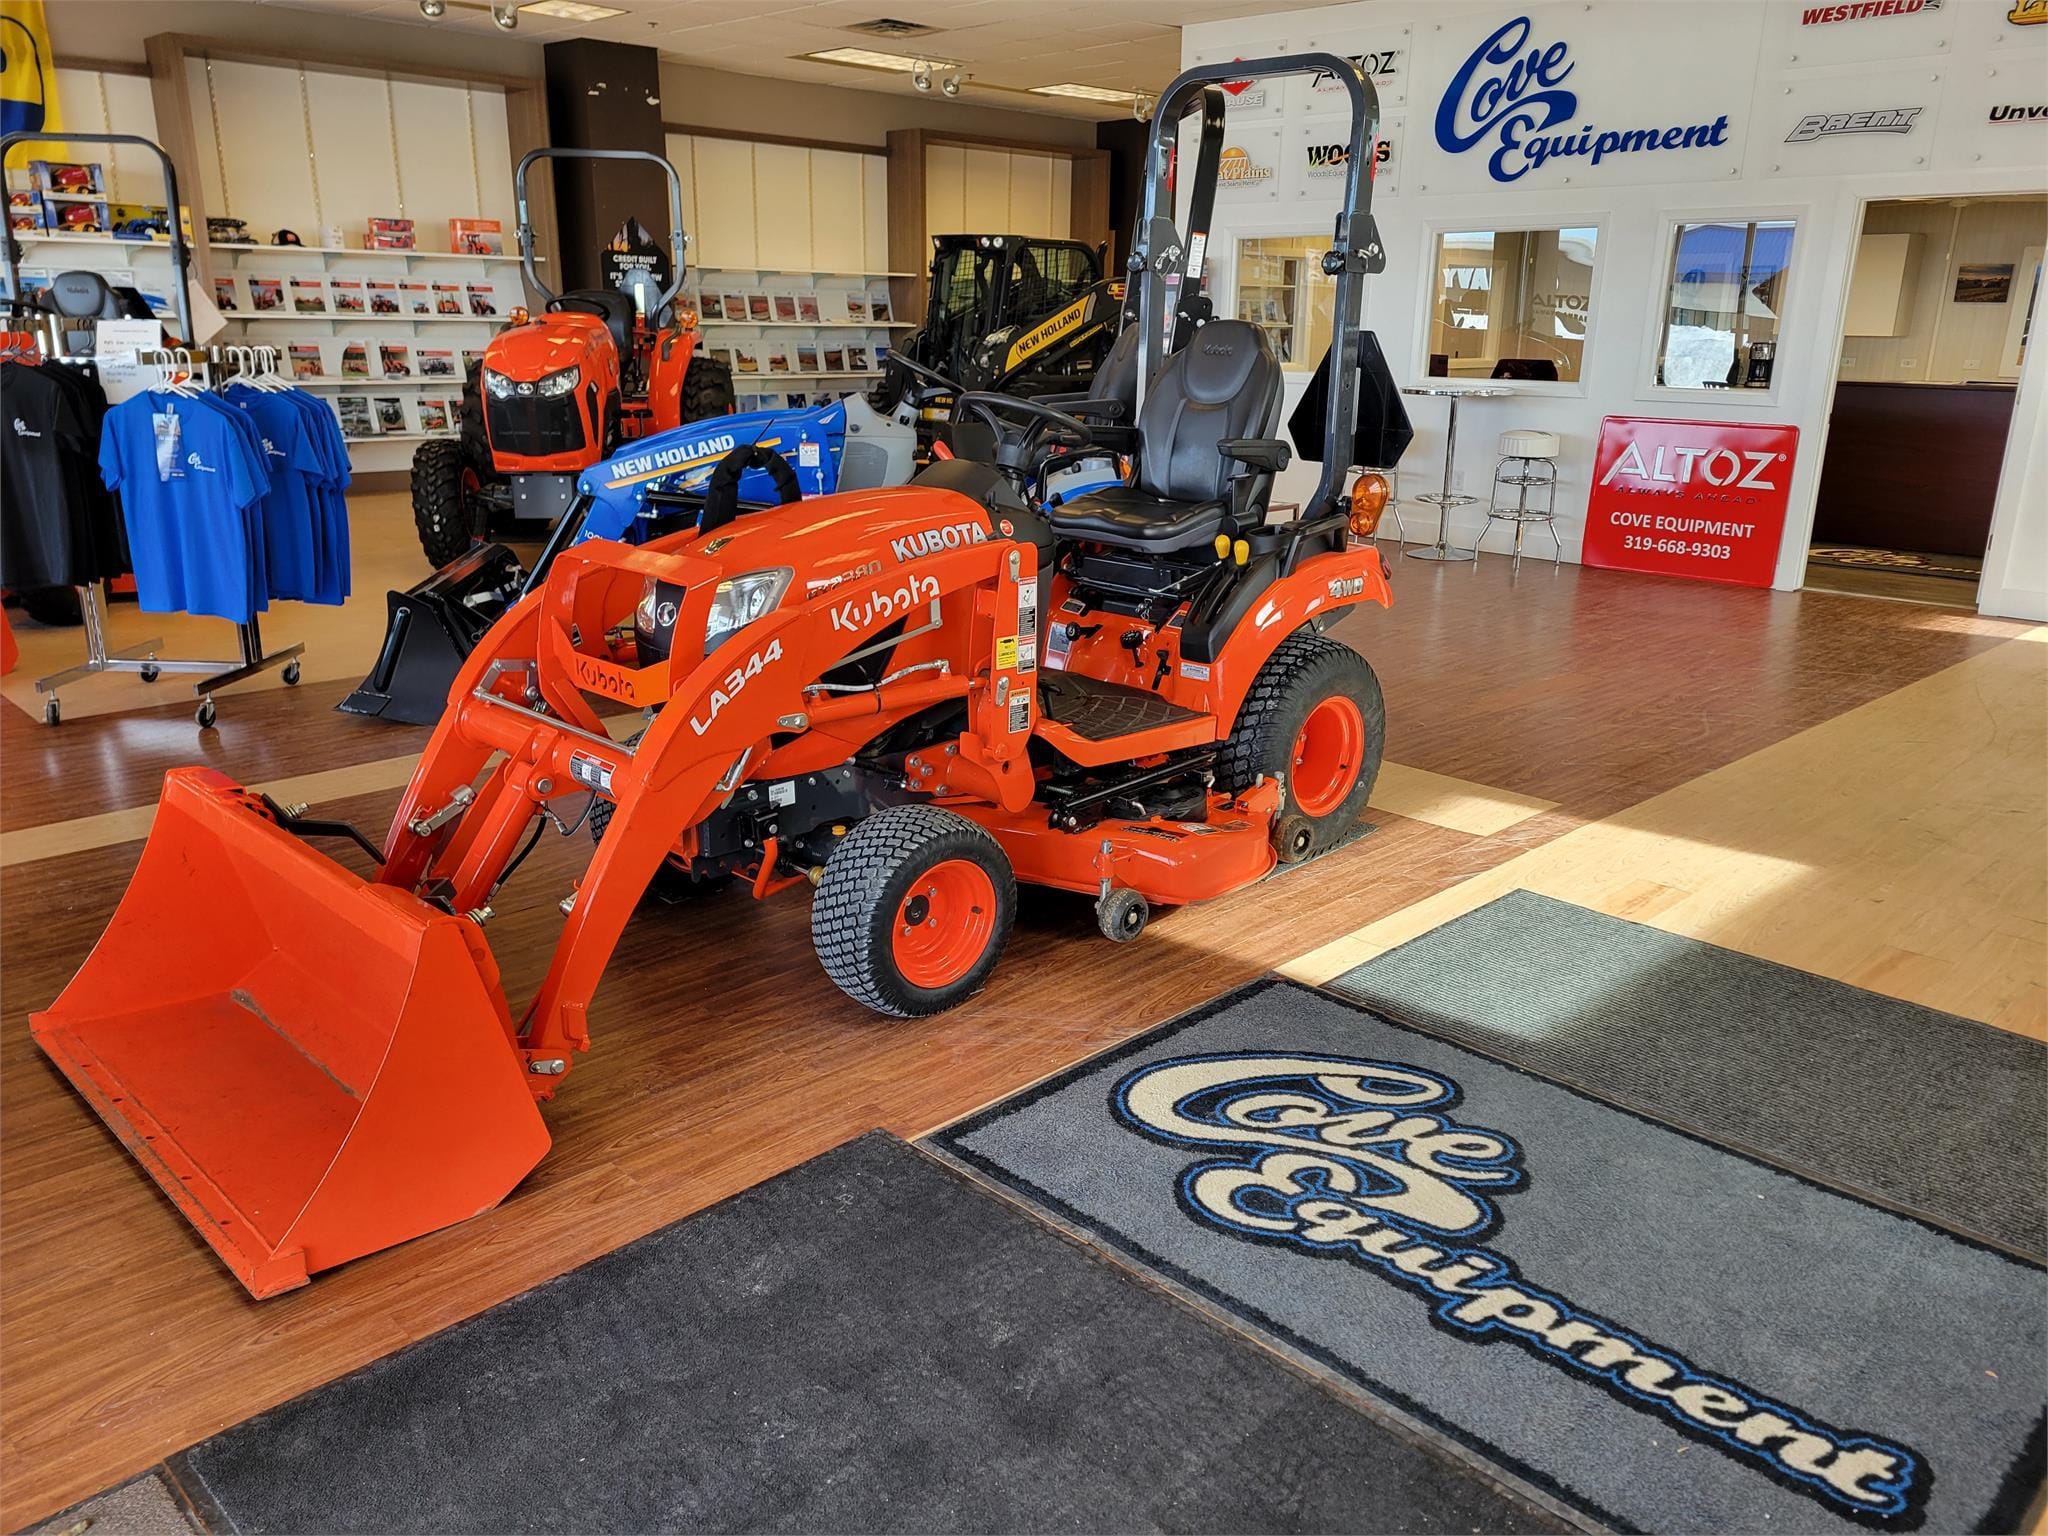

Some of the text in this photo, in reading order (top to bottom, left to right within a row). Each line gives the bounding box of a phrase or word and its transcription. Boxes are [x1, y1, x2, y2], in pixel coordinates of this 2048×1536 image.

[1802, 0, 1923, 25] WESTFIELD
[1224, 94, 1264, 107] AUSE
[1435, 16, 1577, 153] Cove
[1785, 107, 1923, 142] BRENT
[1307, 140, 1392, 166] WOS
[1489, 114, 1728, 182] Equipment
[613, 254, 657, 264] CREDIT BUILT
[620, 263, 634, 271] FOR
[1018, 333, 1040, 354] NEW
[1041, 308, 1081, 341] HOLLAND
[611, 434, 735, 480] NEW HOLLAND
[1615, 486, 1685, 499] ALWAYS
[890, 521, 988, 563] KUBOTA
[1610, 511, 1755, 538] COVE EQUIPMENT
[1624, 535, 1731, 560] 319-668-9303
[830, 574, 940, 632] Kubota
[1328, 576, 1364, 599] 4WD
[576, 657, 635, 699] Kubota
[689, 638, 783, 736] LA344
[1122, 1054, 1520, 1233] Cove
[1193, 1152, 1897, 1504] Equipment
